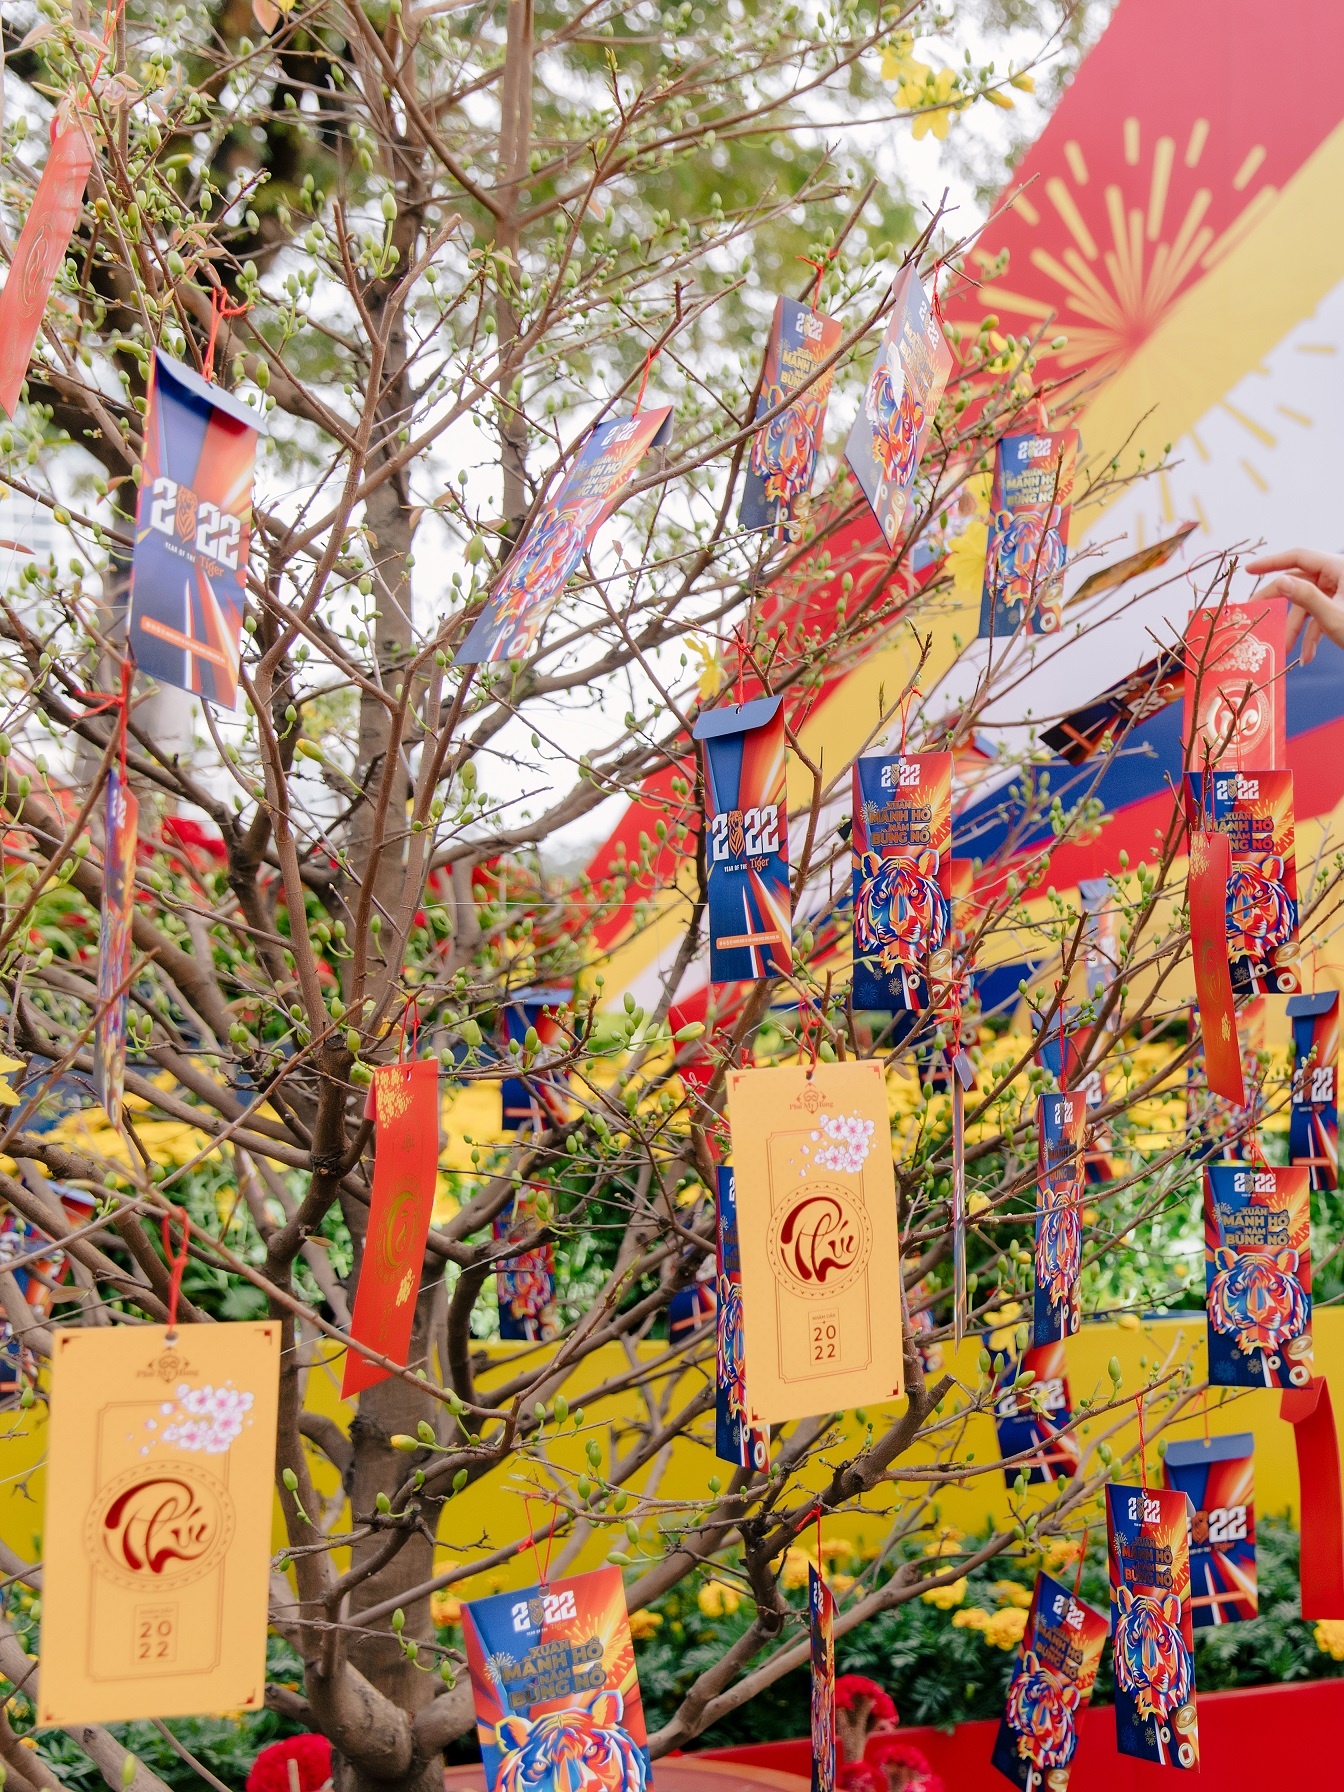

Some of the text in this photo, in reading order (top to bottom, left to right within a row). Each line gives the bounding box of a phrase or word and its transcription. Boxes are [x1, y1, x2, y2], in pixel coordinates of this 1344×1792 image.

[200, 555, 225, 577] Tiger
[724, 865, 734, 873] YEAR
[750, 856, 770, 872] Tiger
[1268, 1210, 1290, 1227] HỔ
[1225, 1228, 1290, 1246] BÙNG NỔ
[814, 1325, 836, 1342] 20
[814, 1343, 836, 1360] 22
[140, 1620, 172, 1639] 20
[139, 1641, 169, 1660] 22
[502, 1636, 604, 1680] MÃNH HỔ
[530, 1640, 570, 1659] XUÂN
[540, 1667, 572, 1684] NĂM
[510, 1662, 606, 1708] BÙNG NỔ
